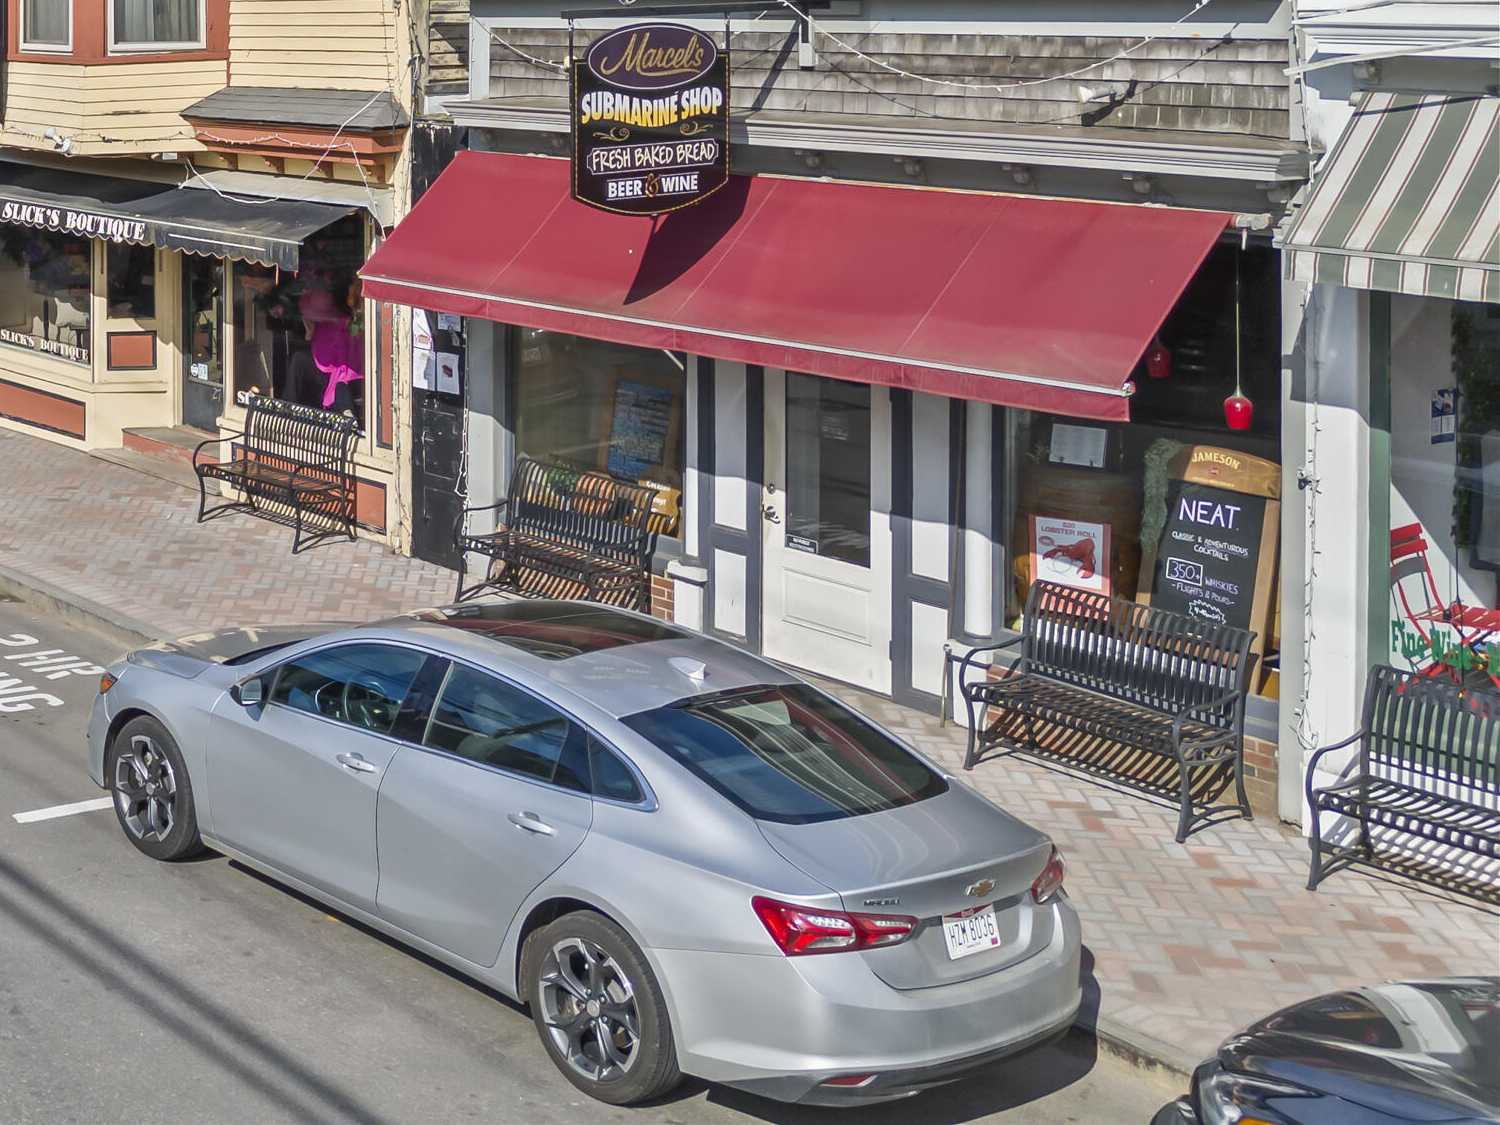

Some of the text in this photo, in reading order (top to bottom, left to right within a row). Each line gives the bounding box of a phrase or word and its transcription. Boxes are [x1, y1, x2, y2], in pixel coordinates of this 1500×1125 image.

[601, 32, 705, 76] Marcel's
[582, 86, 722, 127] SUBMARINE SHOP
[592, 142, 715, 172] FRESH BAKED BREAD
[608, 173, 699, 198] BEER & WINE
[2, 202, 145, 243] SLICK'S BOUTIQUE
[1, 329, 88, 361] SLICK'S BOUTIQUE
[1192, 452, 1240, 470] JAMESON
[1041, 526, 1097, 539] LOBSTER ROLL
[1172, 531, 1195, 542] CLASSIC
[1204, 538, 1249, 556] ADVENTUROUS
[1194, 544, 1229, 561] COCKTAILS
[1170, 561, 1239, 595] 350+ WHISKIES
[1391, 620, 1426, 659] Fine
[1430, 628, 1474, 670] Wine
[3, 649, 107, 680] HR
[948, 914, 995, 948] HZM 8036
